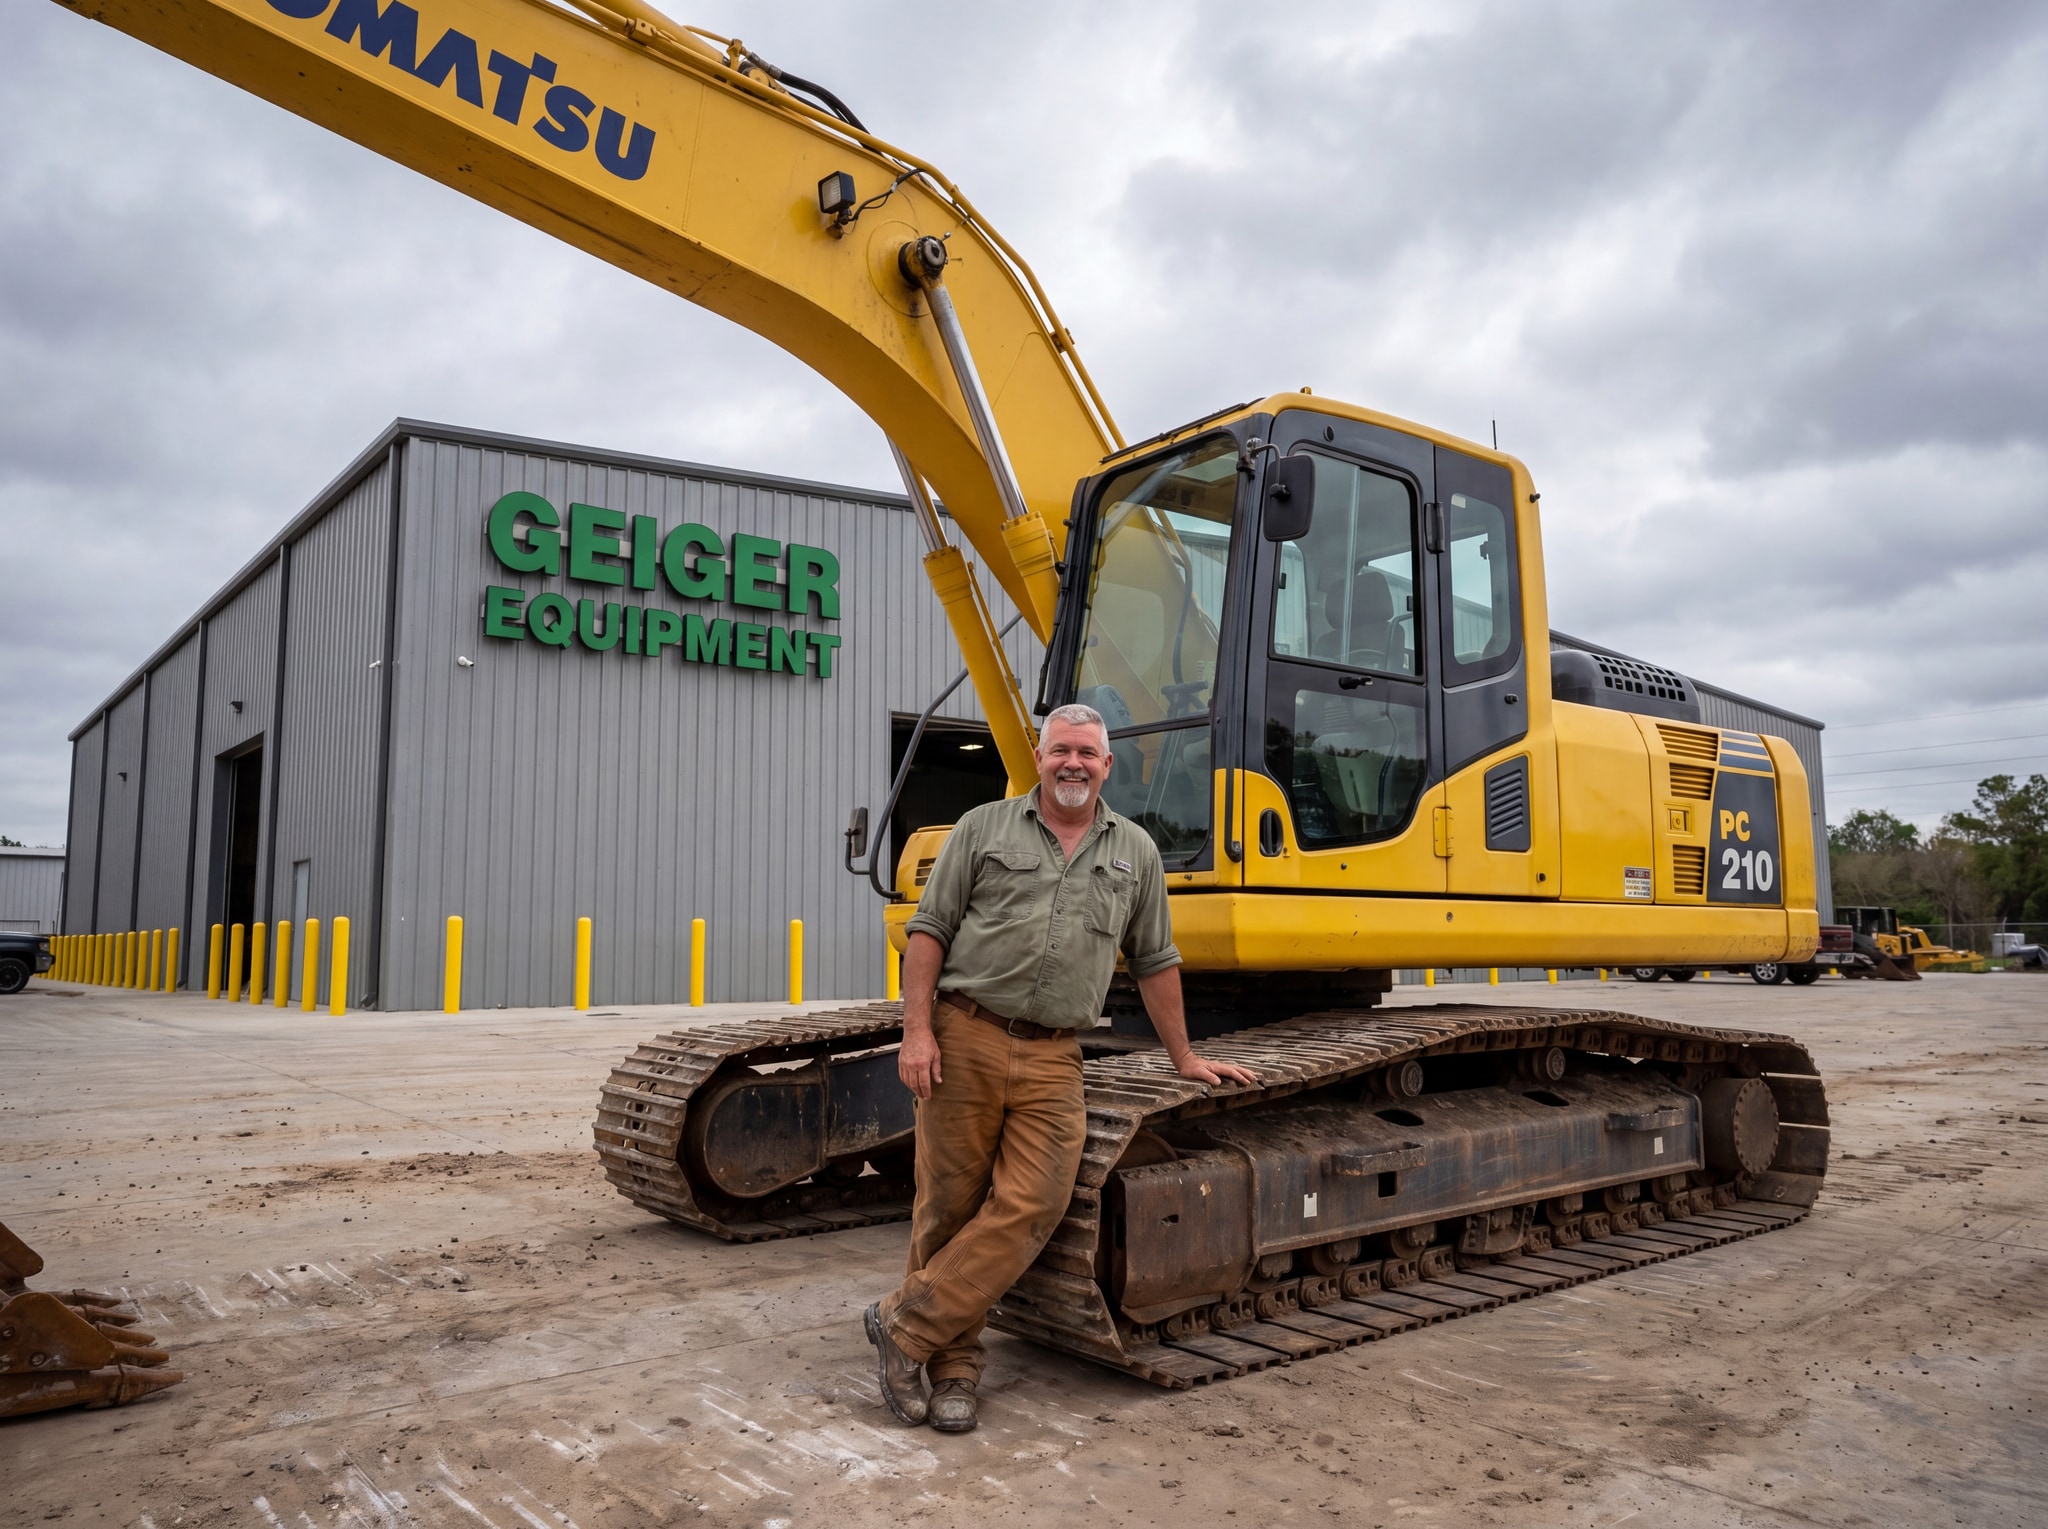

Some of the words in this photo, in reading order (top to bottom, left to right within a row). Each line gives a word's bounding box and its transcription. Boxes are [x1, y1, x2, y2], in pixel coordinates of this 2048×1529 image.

[265, 0, 656, 181] MATSU
[486, 491, 841, 620] GEIGER
[484, 585, 842, 678] EQUIPMENT
[1719, 809, 1751, 842] PC
[1721, 848, 1774, 892] 210
